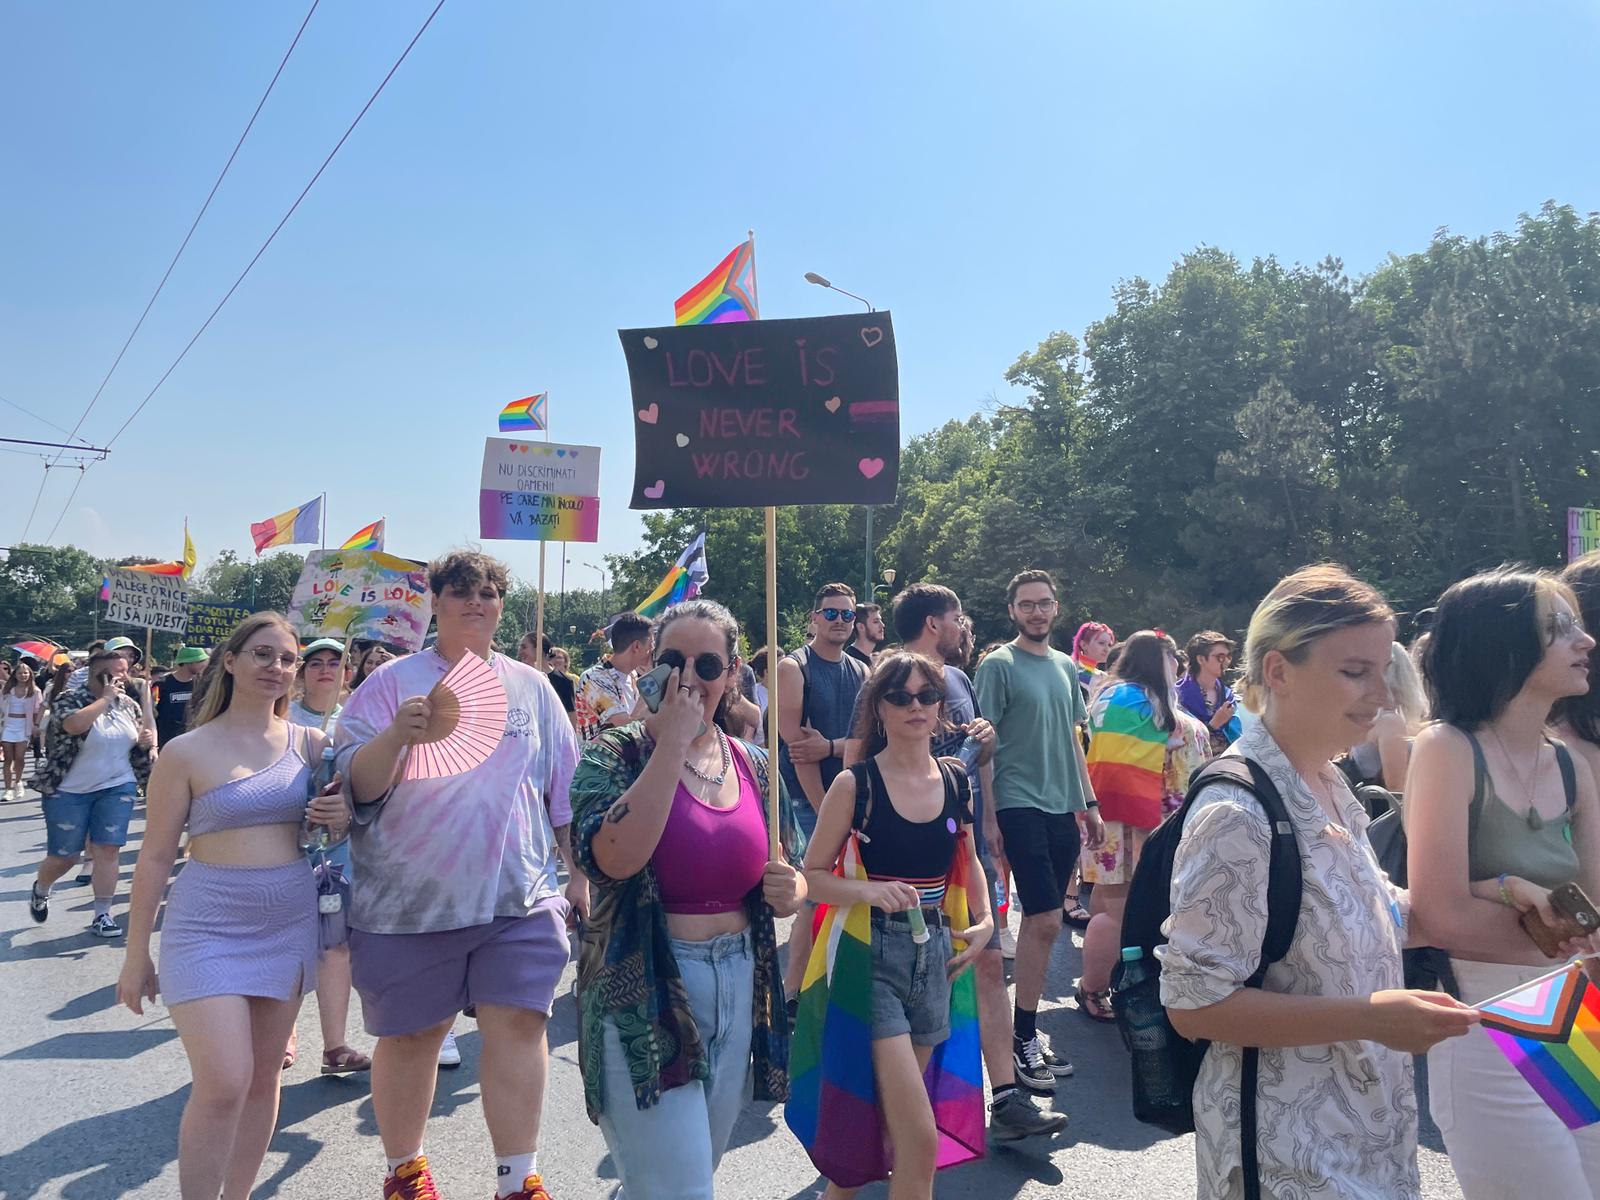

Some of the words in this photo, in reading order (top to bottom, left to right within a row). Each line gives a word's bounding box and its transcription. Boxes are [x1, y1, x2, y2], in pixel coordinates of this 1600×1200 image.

[665, 349, 767, 387] LOVE
[699, 407, 801, 438] NEVER
[498, 463, 514, 476] NU
[691, 450, 809, 480] WRONG
[517, 478, 555, 492] OAMENII
[500, 492, 513, 505] PE
[518, 494, 540, 507] CARE
[112, 591, 142, 608] ALEGE
[115, 578, 148, 594] ALEGE
[151, 585, 187, 604] ORICE
[312, 579, 354, 596] LOVE
[361, 590, 376, 603] IS
[383, 587, 424, 609] LOVE
